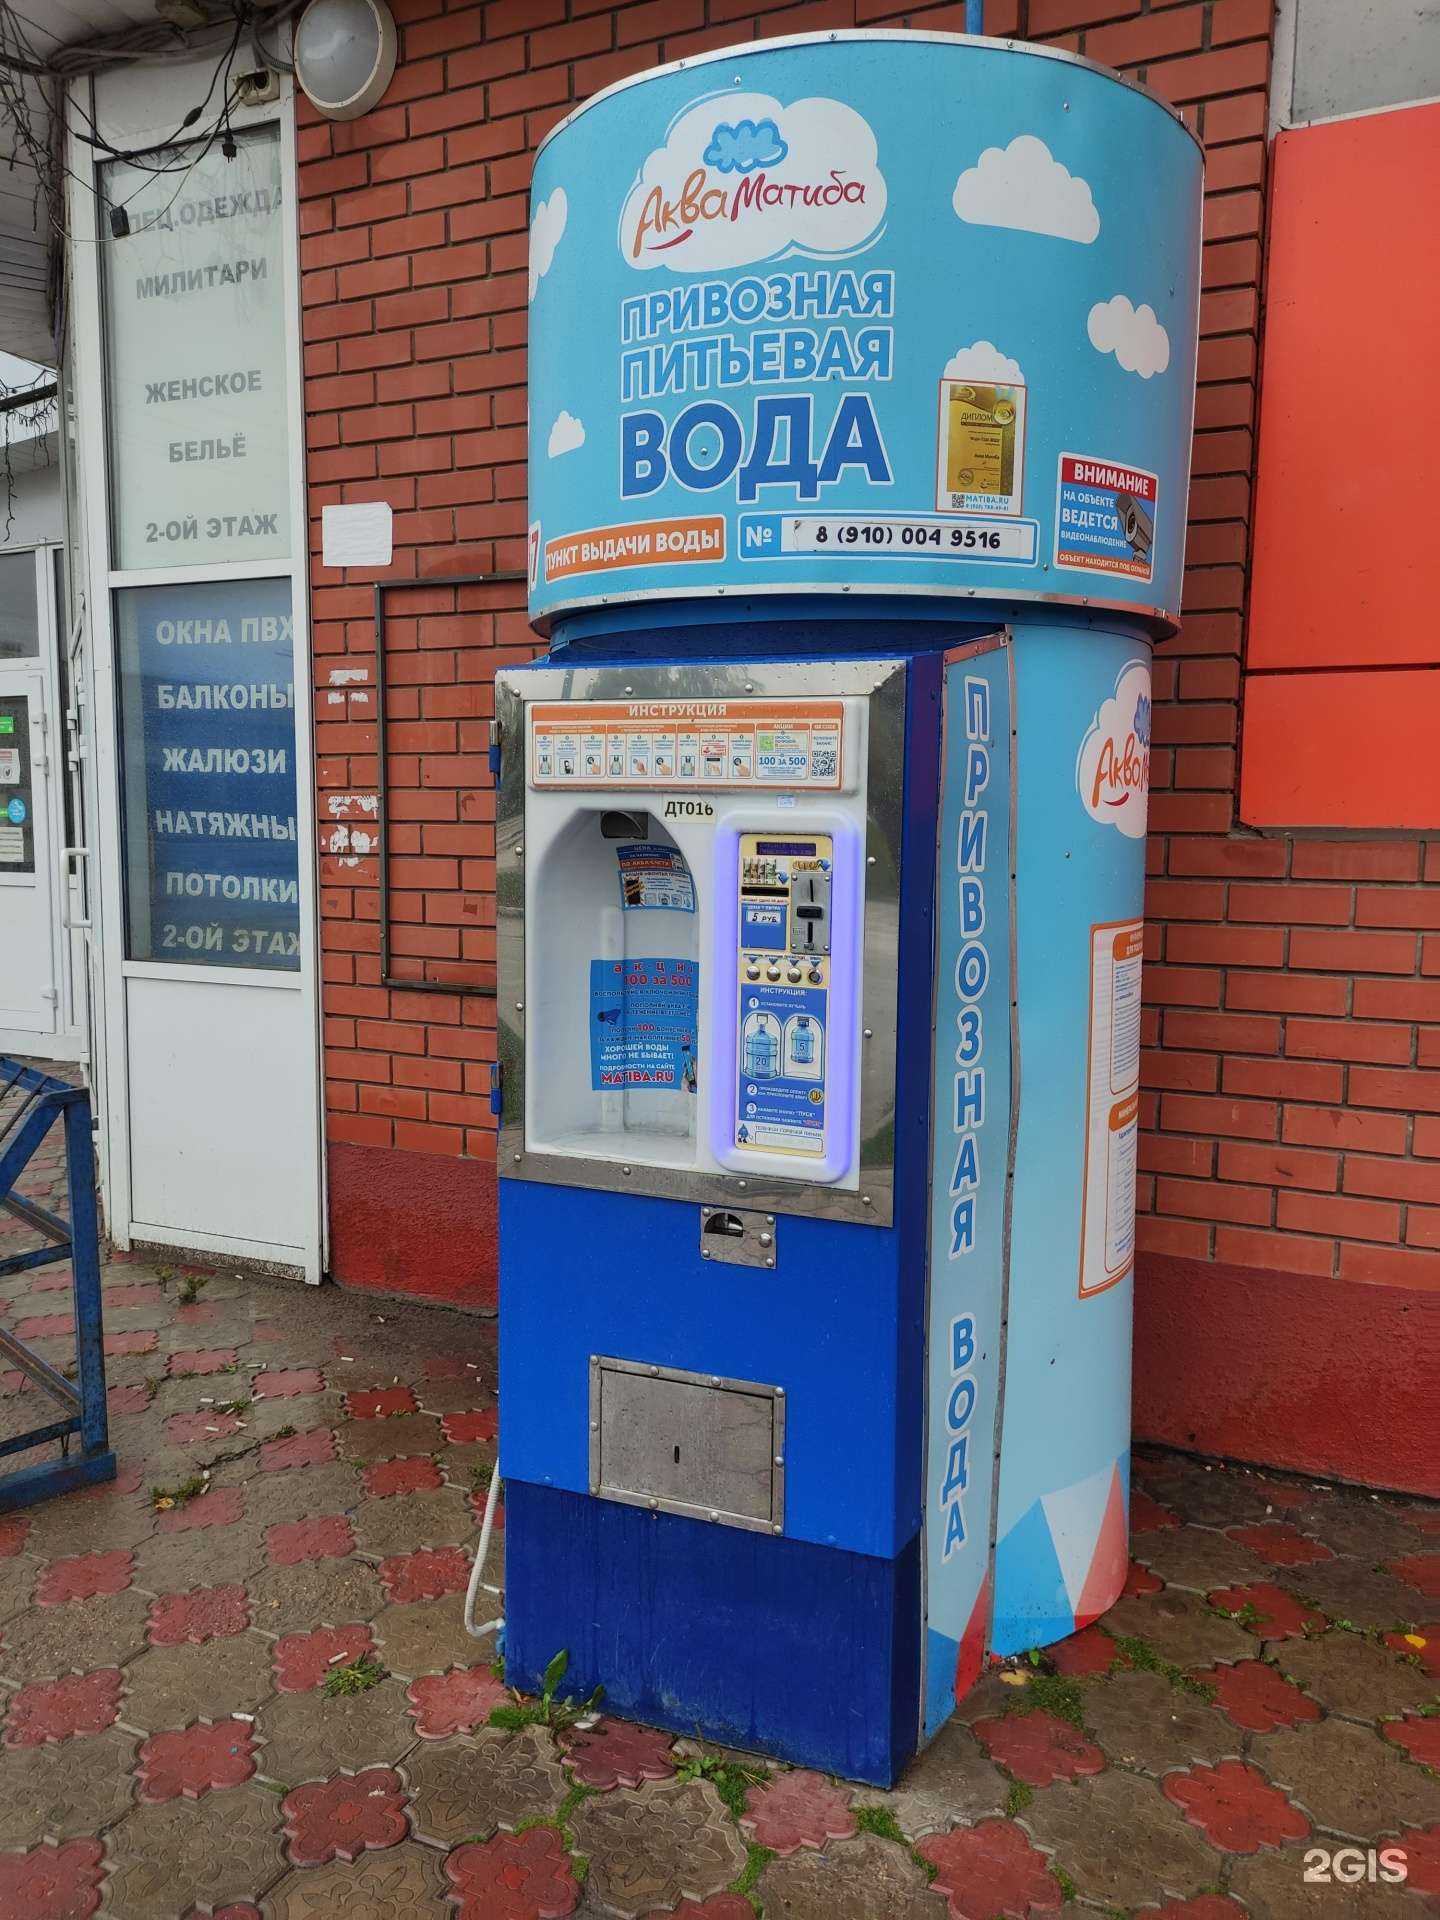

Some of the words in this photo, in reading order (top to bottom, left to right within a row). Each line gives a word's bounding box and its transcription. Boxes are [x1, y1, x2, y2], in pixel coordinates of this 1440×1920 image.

[136, 257, 268, 300] МИЛИТАРИ
[621, 271, 895, 343] ПРИВОЗНАЯ
[621, 326, 893, 402] ПИТЬЕВАЯ
[145, 369, 262, 404] ЖЕНСКОЕ
[961, 412, 993, 422] ДИПЛОМ
[168, 433, 247, 464] БЕЛЬЁ
[620, 393, 894, 503] ВОДА
[1074, 462, 1149, 496] ВНИМАНИЕ
[1063, 490, 1076, 502] НА
[1078, 492, 1115, 509] ОБЪЕКТЕ
[145, 513, 198, 543] 2-ОЙ
[206, 513, 278, 541] ЭТАЖ
[1062, 508, 1119, 531] ВЕДЕТСЯ
[745, 525, 772, 547] №
[815, 526, 828, 543] 8
[836, 526, 893, 545] (910)
[901, 527, 941, 546] 004
[950, 529, 1001, 549] 9516
[1060, 530, 1127, 549] ВИДЕОНАБЛЮДЕНИЕ
[546, 545, 578, 573] ПУНКТ
[581, 533, 651, 562] ВЫДАЧИ
[655, 528, 720, 554] ВОДЫ
[1060, 553, 1084, 561] ОБЪЕКТ
[1085, 557, 1118, 569] НАХОДИТСЯ
[156, 619, 232, 645] ОКНА
[241, 616, 294, 643] ПВХ
[157, 684, 295, 709] БАЛКОНЫ
[628, 703, 728, 719] ИНСТРУКЦИЯ
[162, 748, 286, 774] ЖАЛЮЗИ
[759, 757, 775, 765] 100
[788, 757, 806, 765] 500
[664, 801, 714, 817] ДТ016
[155, 810, 296, 841] НАТЯЖНЫ
[166, 871, 297, 904] ПОТОЛКИ
[752, 912, 759, 922] 5
[162, 922, 223, 951] 2-ОЙ
[949, 676, 990, 1261] ПРИВОЗНАЯ
[605, 1042, 644, 1052] ХОРОШЕЙ
[646, 1043, 668, 1052] ВОДЫ
[799, 1042, 805, 1050] 5
[755, 1056, 767, 1066] 20
[601, 1071, 675, 1084] MATIBA.RU
[749, 1104, 755, 1112] 3
[941, 1313, 976, 1562] ВОДА
